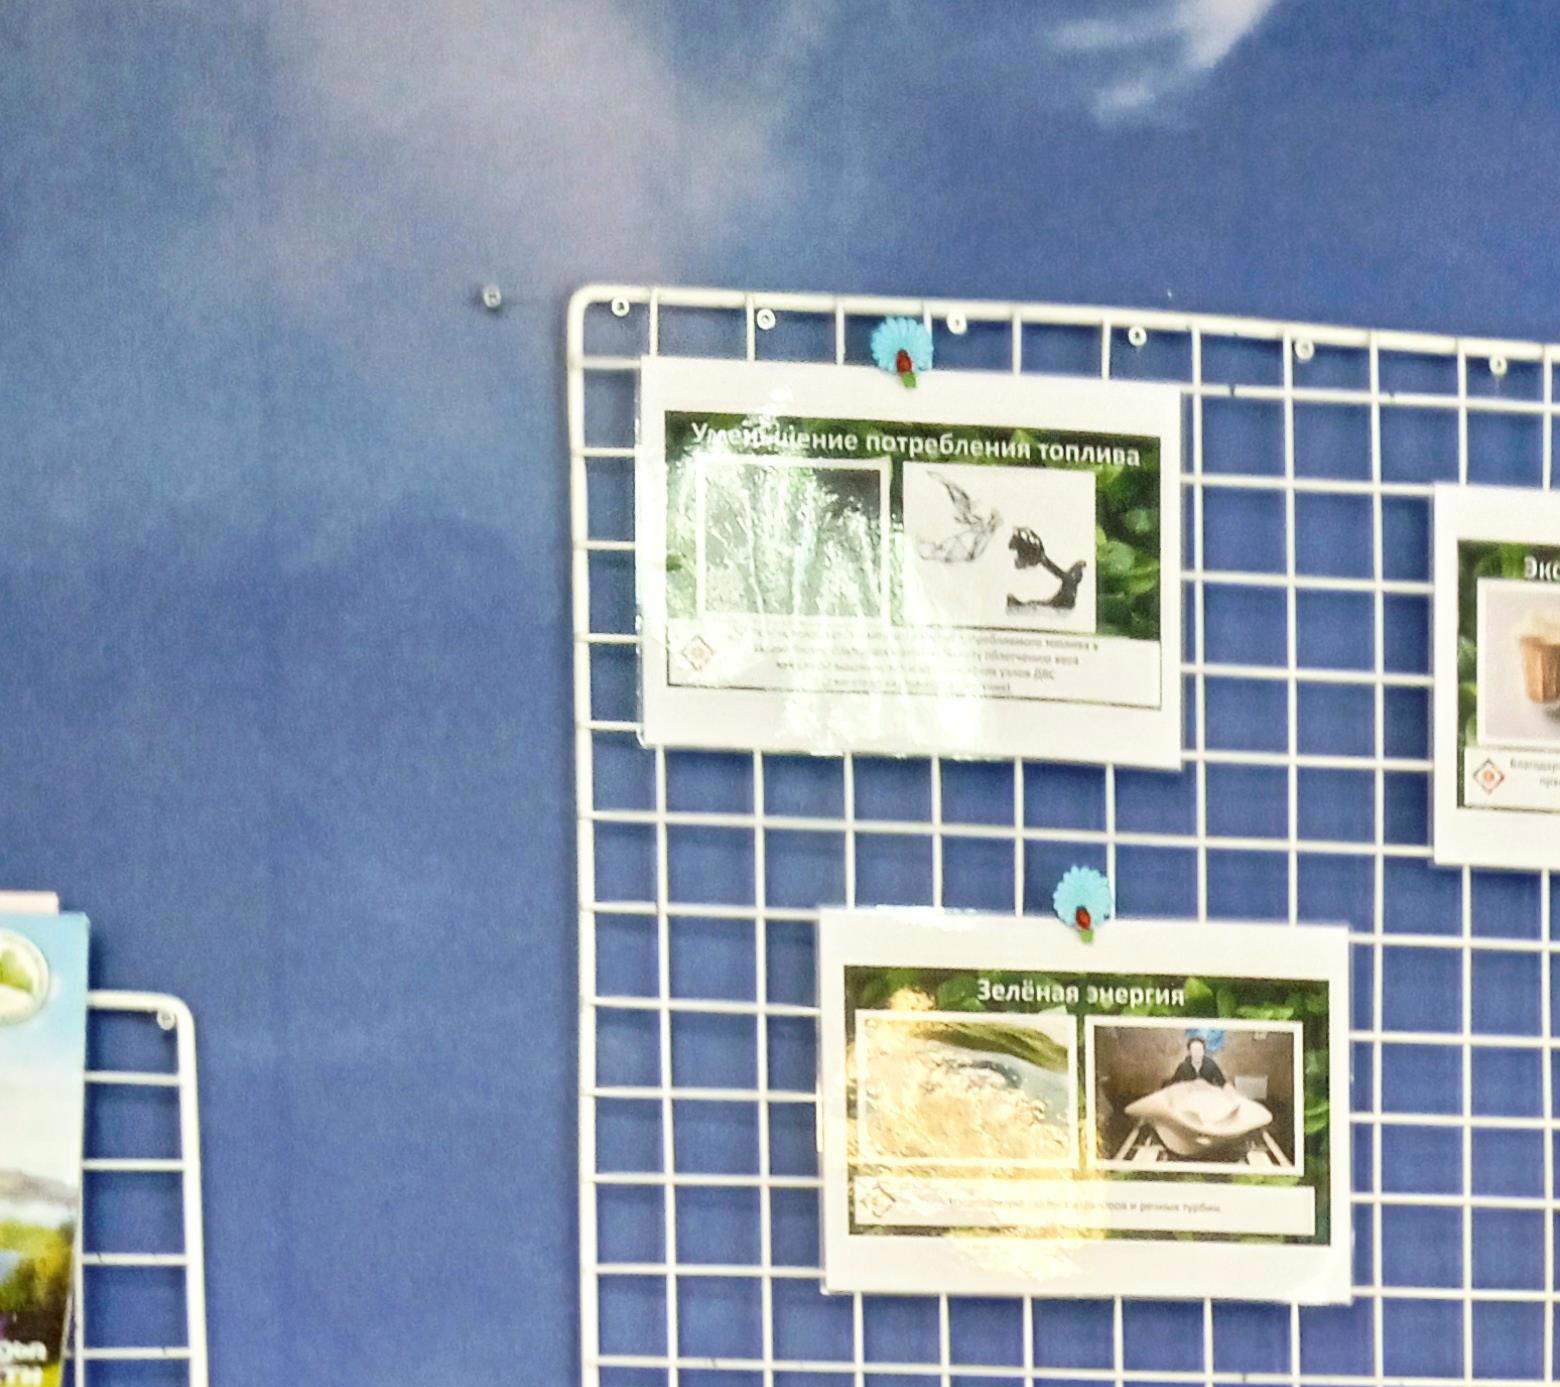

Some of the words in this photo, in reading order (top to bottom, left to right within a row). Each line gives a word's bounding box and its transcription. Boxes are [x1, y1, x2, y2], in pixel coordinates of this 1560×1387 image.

[866, 433, 1031, 460] потребления
[1039, 443, 1141, 467] топлива
[976, 977, 1080, 1004] Зелёная
[1086, 984, 1186, 1010] энергия
